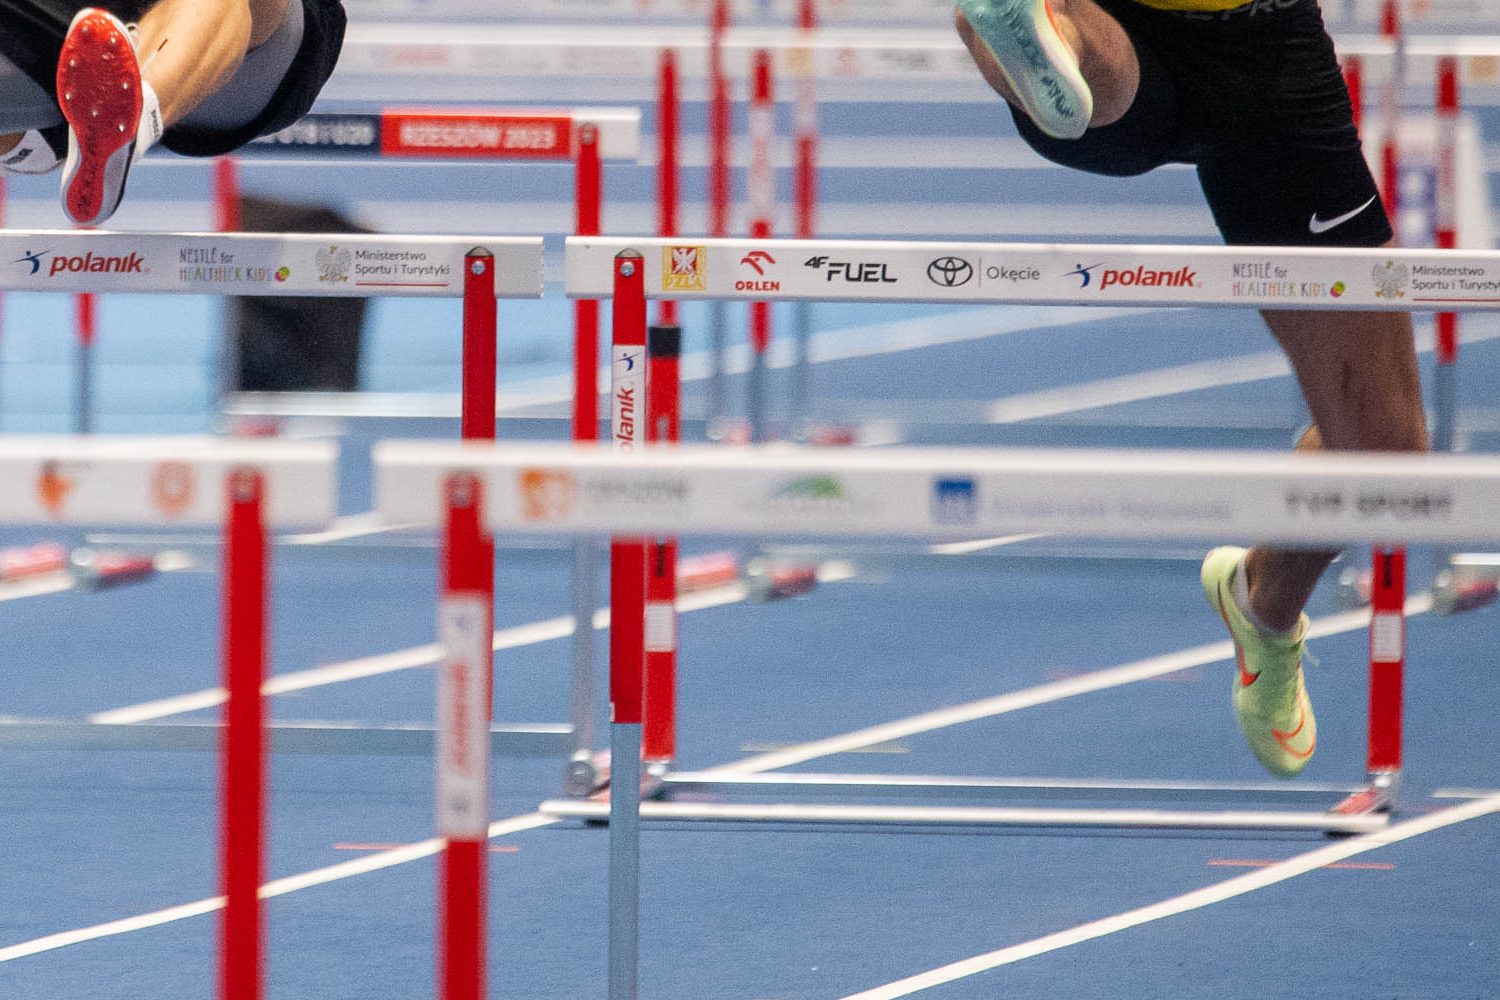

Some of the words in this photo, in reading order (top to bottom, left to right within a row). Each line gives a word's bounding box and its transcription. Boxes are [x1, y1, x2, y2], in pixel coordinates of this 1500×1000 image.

[219, 252, 234, 264] for
[355, 249, 427, 262] Ministerstwo
[49, 251, 145, 277] polanik
[355, 263, 392, 276] Sportu
[400, 263, 451, 278] Turystyki
[1412, 265, 1485, 277] Ministerstwo
[179, 265, 242, 282] HEALTHIER
[245, 266, 273, 283] KIDS
[827, 263, 898, 283] FUEL
[986, 265, 1041, 282] Okęcie
[1100, 265, 1197, 291] polanik
[1274, 266, 1288, 280] for
[735, 280, 781, 292] ORLEN
[1232, 281, 1296, 298] HEALTHIER
[1301, 281, 1327, 298] KIDS
[1412, 279, 1449, 291] Sportu
